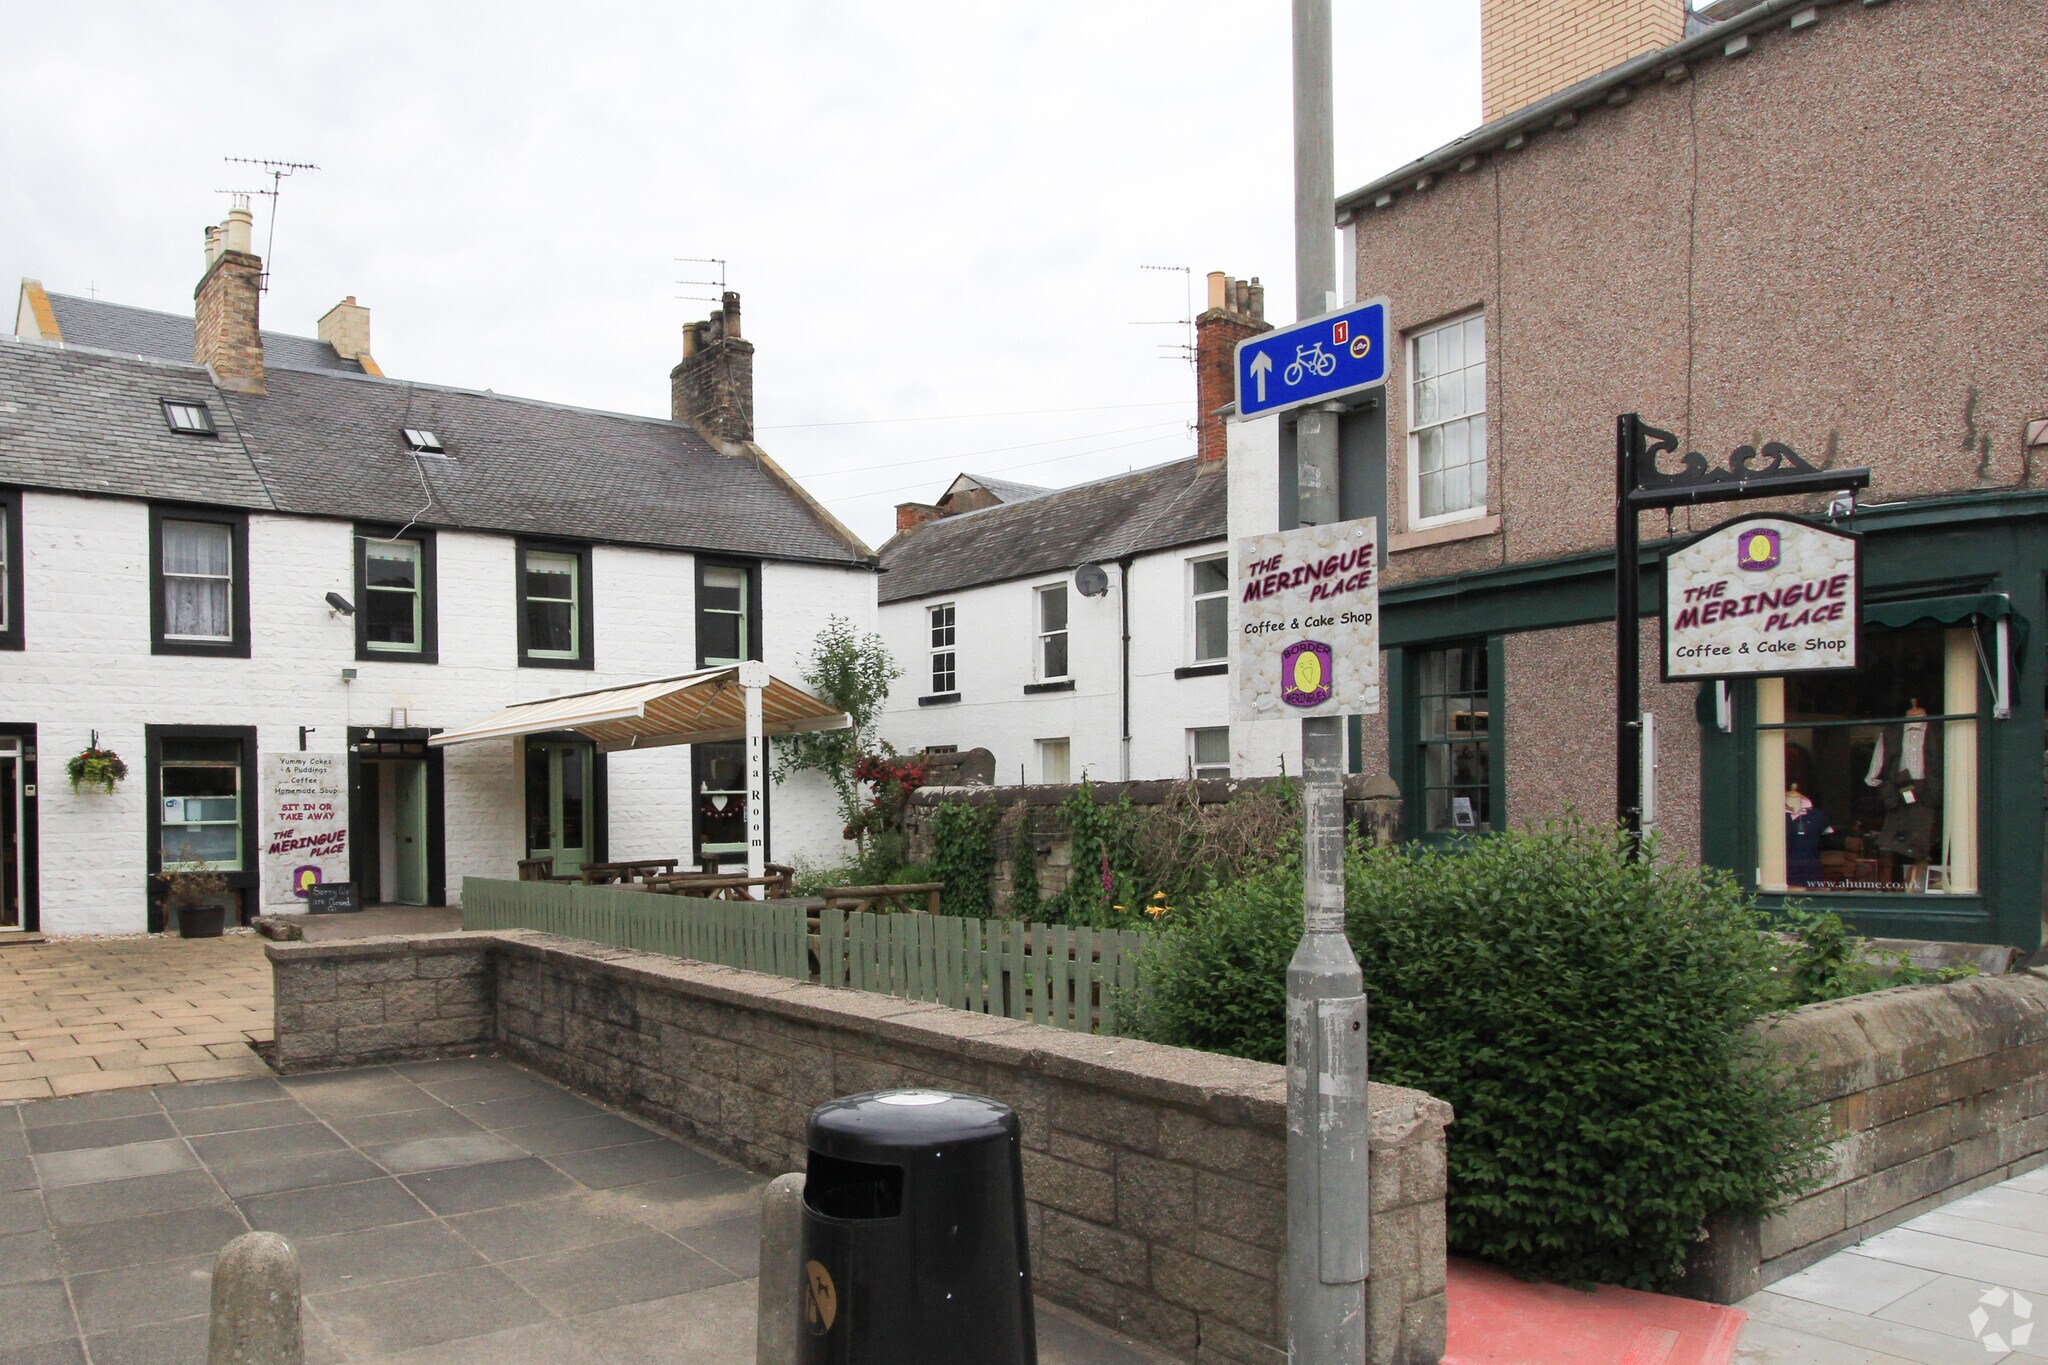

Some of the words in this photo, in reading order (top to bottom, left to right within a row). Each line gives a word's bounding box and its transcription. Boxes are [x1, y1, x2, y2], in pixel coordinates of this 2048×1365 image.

[1338, 326, 1343, 340] 1
[1243, 542, 1374, 604] MERINGUE
[1249, 553, 1283, 577] THE
[1309, 570, 1372, 603] PLACE
[1683, 580, 1729, 604] THE
[1674, 573, 1849, 631] MERINGUE
[1244, 622, 1285, 635] Coffee
[1290, 618, 1300, 630] &
[1304, 614, 1335, 628] Cake
[1340, 611, 1373, 625] Shop
[1763, 601, 1846, 633] PLACE
[1283, 643, 1331, 659] BORDER
[1676, 644, 1731, 658] Coffee
[1738, 642, 1750, 654] &
[1757, 639, 1797, 653] Cake
[1804, 637, 1847, 653] Shop
[1286, 691, 1327, 703] MERINGUES
[279, 758, 307, 766] Yummy
[309, 757, 332, 765] Cakes
[751, 736, 760, 778] Tea
[294, 766, 327, 775] Puddings
[274, 787, 316, 795] Homemade
[319, 787, 338, 796] Soup
[281, 803, 301, 811] SIT
[303, 803, 316, 811] IN
[319, 803, 332, 811] OR
[279, 812, 303, 821] TAKE
[307, 812, 335, 820] AWAY
[751, 790, 762, 847] Room
[268, 829, 347, 855] MERINGUE
[273, 829, 294, 840] THE
[309, 843, 345, 858] PLACE
[1806, 878, 1921, 890] www.ahume.co.uk
